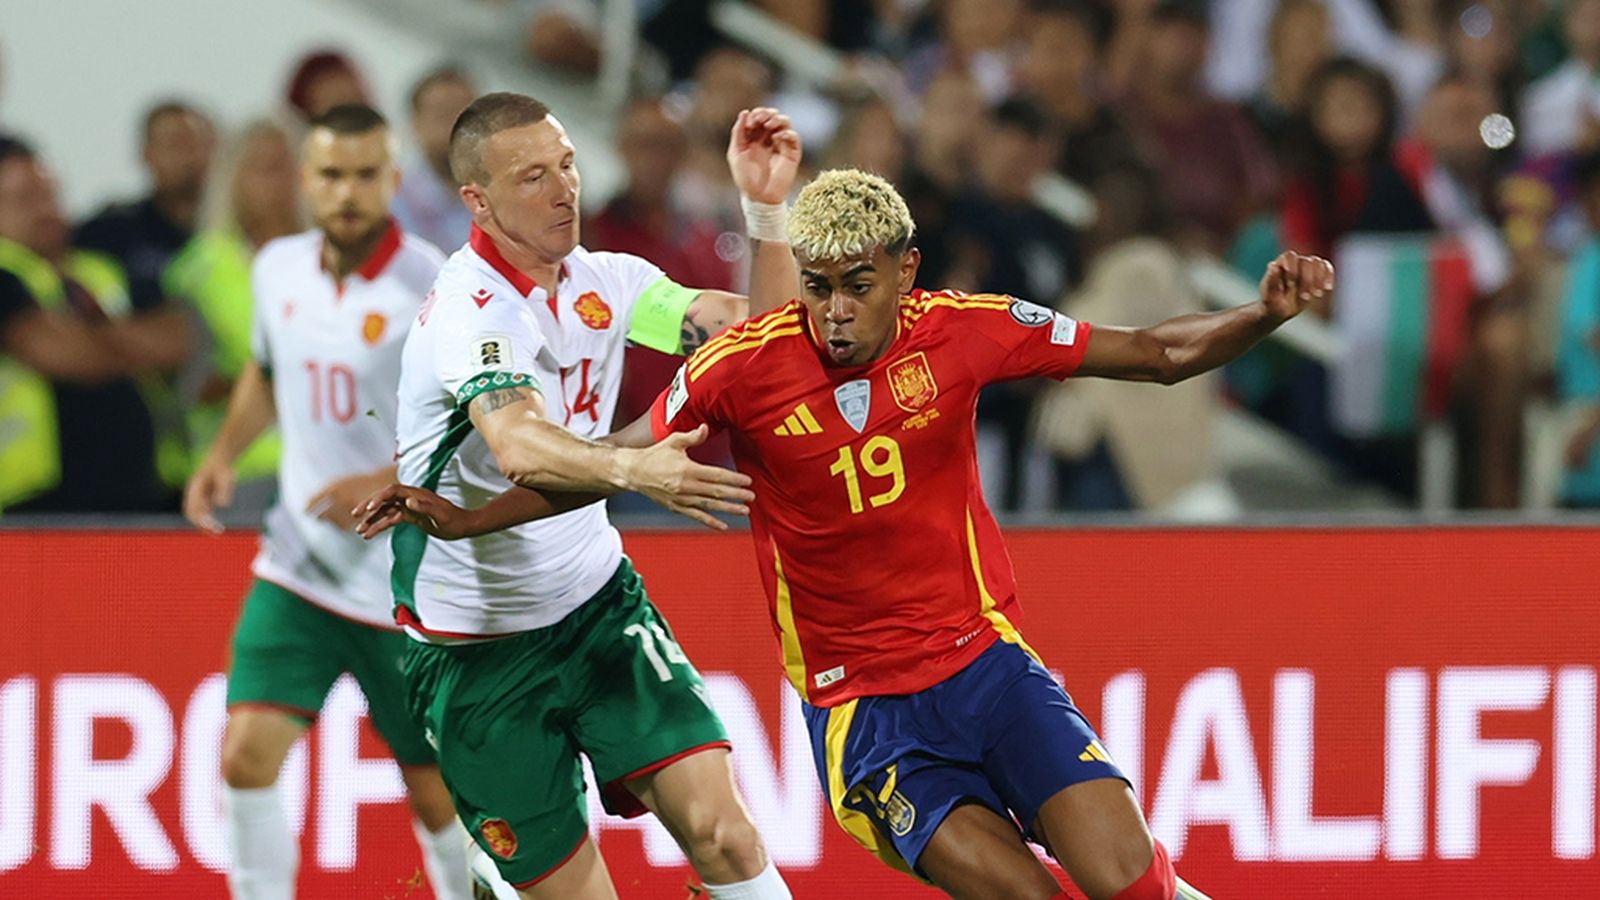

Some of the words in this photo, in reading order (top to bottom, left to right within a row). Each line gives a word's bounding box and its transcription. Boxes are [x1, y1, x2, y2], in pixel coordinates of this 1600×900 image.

[305, 360, 358, 424] 10
[830, 435, 906, 514] 19
[0, 672, 824, 872] ROPN
[1025, 664, 1597, 863] ALIFI
